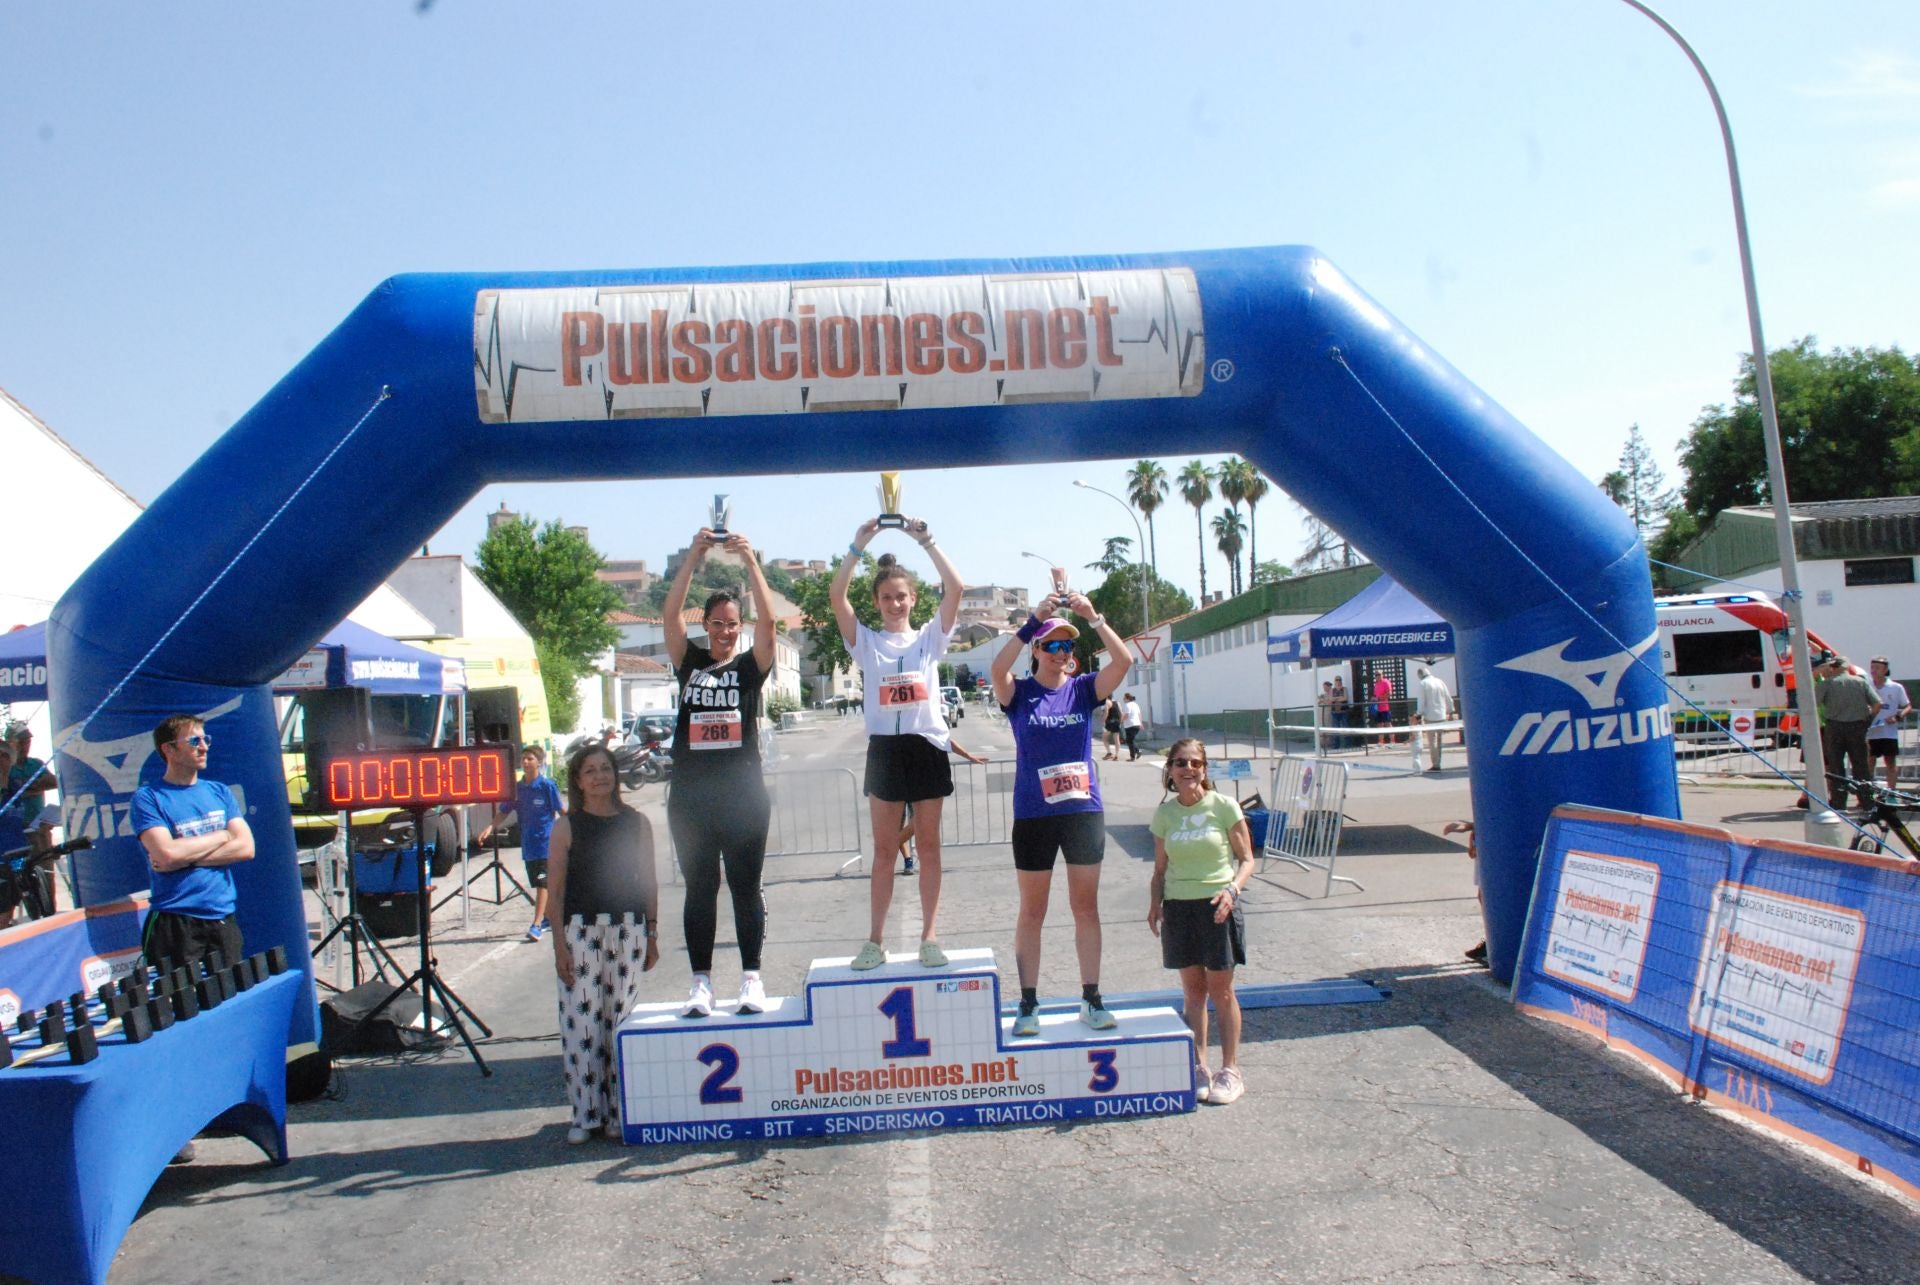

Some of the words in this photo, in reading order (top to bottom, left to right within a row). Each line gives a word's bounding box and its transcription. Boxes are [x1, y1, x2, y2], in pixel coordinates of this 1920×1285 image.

[562, 296, 1123, 386] Pulsaciones.net
[1322, 631, 1447, 648] WWW.PROTEGEBIKE.ES
[1657, 617, 1714, 628] MBULANCIA
[684, 686, 740, 707] PEGAO
[890, 685, 915, 702] 261
[701, 724, 730, 740] 268
[331, 754, 501, 801] 00:00:00
[1053, 775, 1081, 793] 258
[1775, 906, 1808, 924] EVENTOS
[1808, 914, 1856, 936] DEPORTIVOS
[1716, 926, 1836, 985] Pulsaciones.net
[877, 986, 931, 1059] 1
[697, 1043, 743, 1105] 2
[795, 1056, 1019, 1095] Pulsaciones.net
[1088, 1049, 1119, 1092] 3
[771, 1093, 871, 1112] ORGANIZACIÓN
[876, 1093, 893, 1105] DE
[897, 1089, 958, 1104] EVENTOS
[961, 1083, 1045, 1099] DEPORTIVOS
[641, 1123, 733, 1144] RUNNING
[764, 1120, 795, 1137] BTT
[825, 1110, 945, 1134] SENDERISMO
[975, 1101, 1063, 1124] TRIATLÓN
[1095, 1093, 1184, 1116] DUATLÓN
